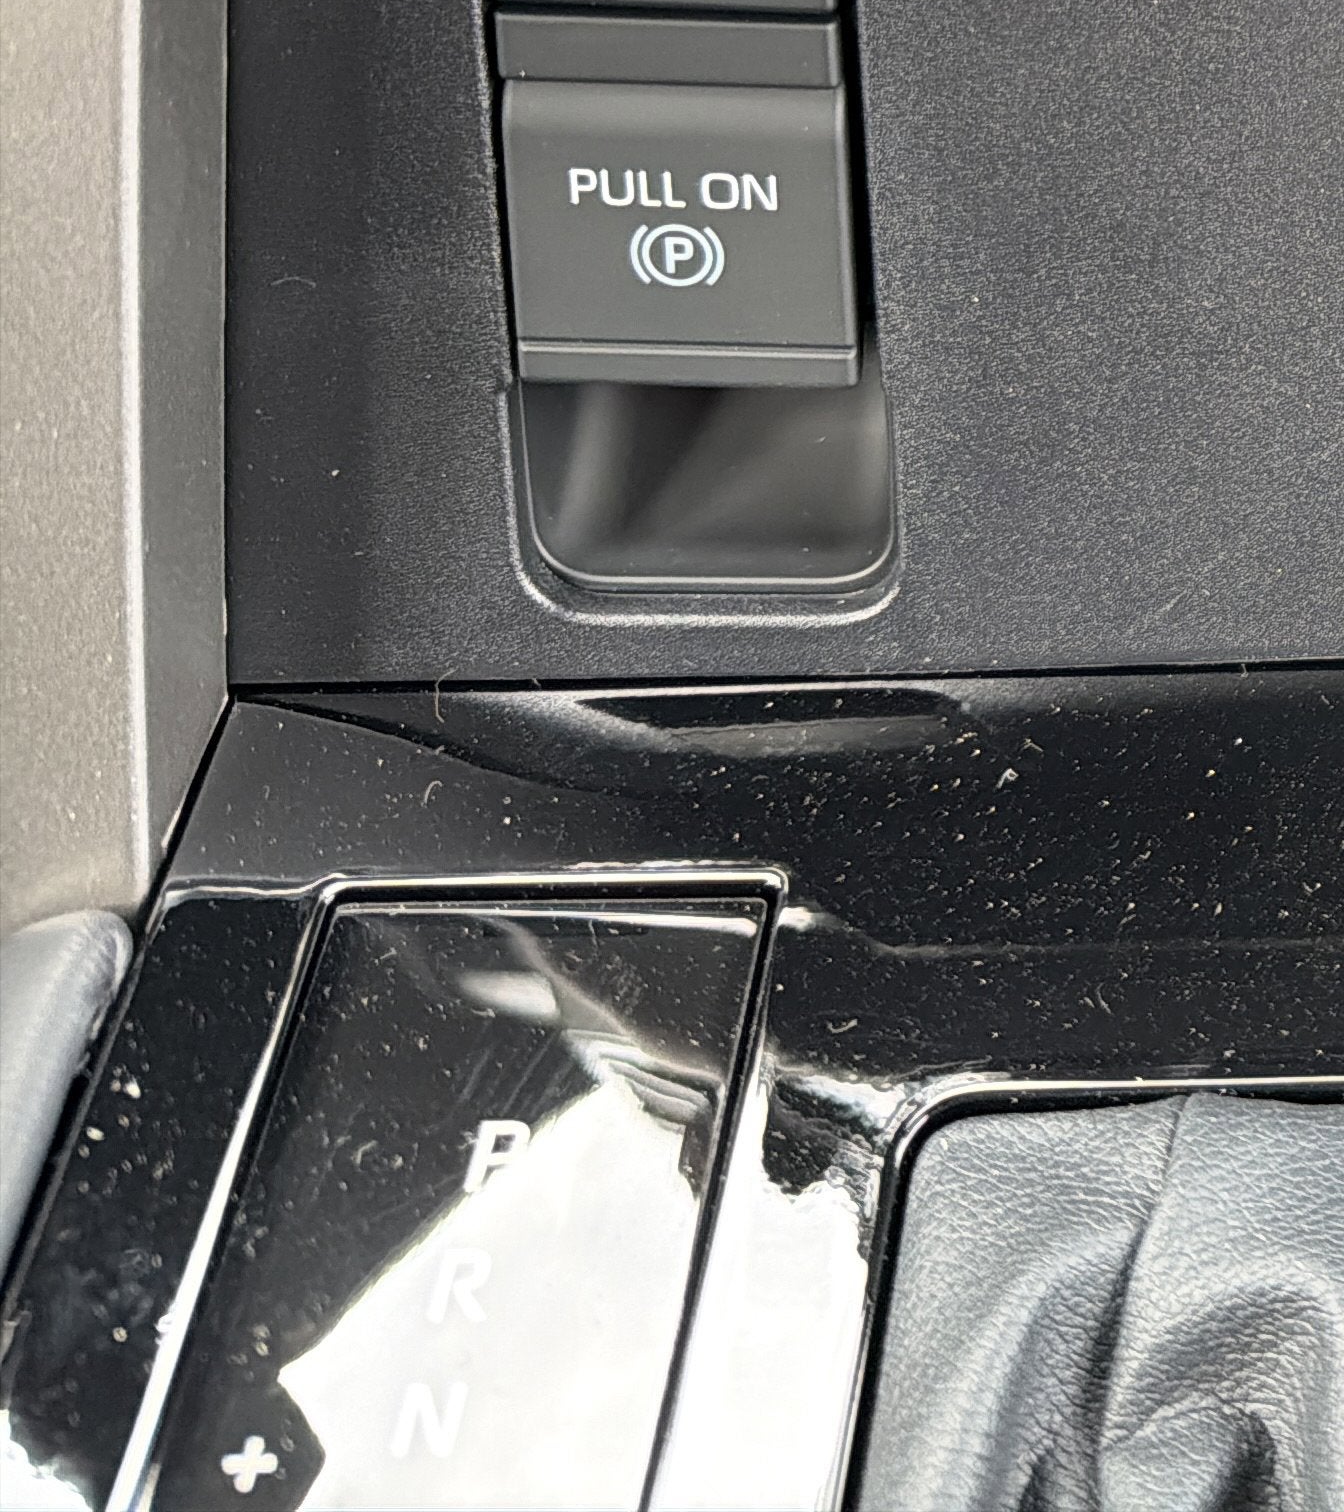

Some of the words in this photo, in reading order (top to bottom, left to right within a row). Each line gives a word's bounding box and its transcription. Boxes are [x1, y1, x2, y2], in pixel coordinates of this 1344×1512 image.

[567, 168, 687, 209] PULL
[699, 172, 779, 212] ON
[426, 1246, 493, 1324] R
[390, 1382, 469, 1459] N
